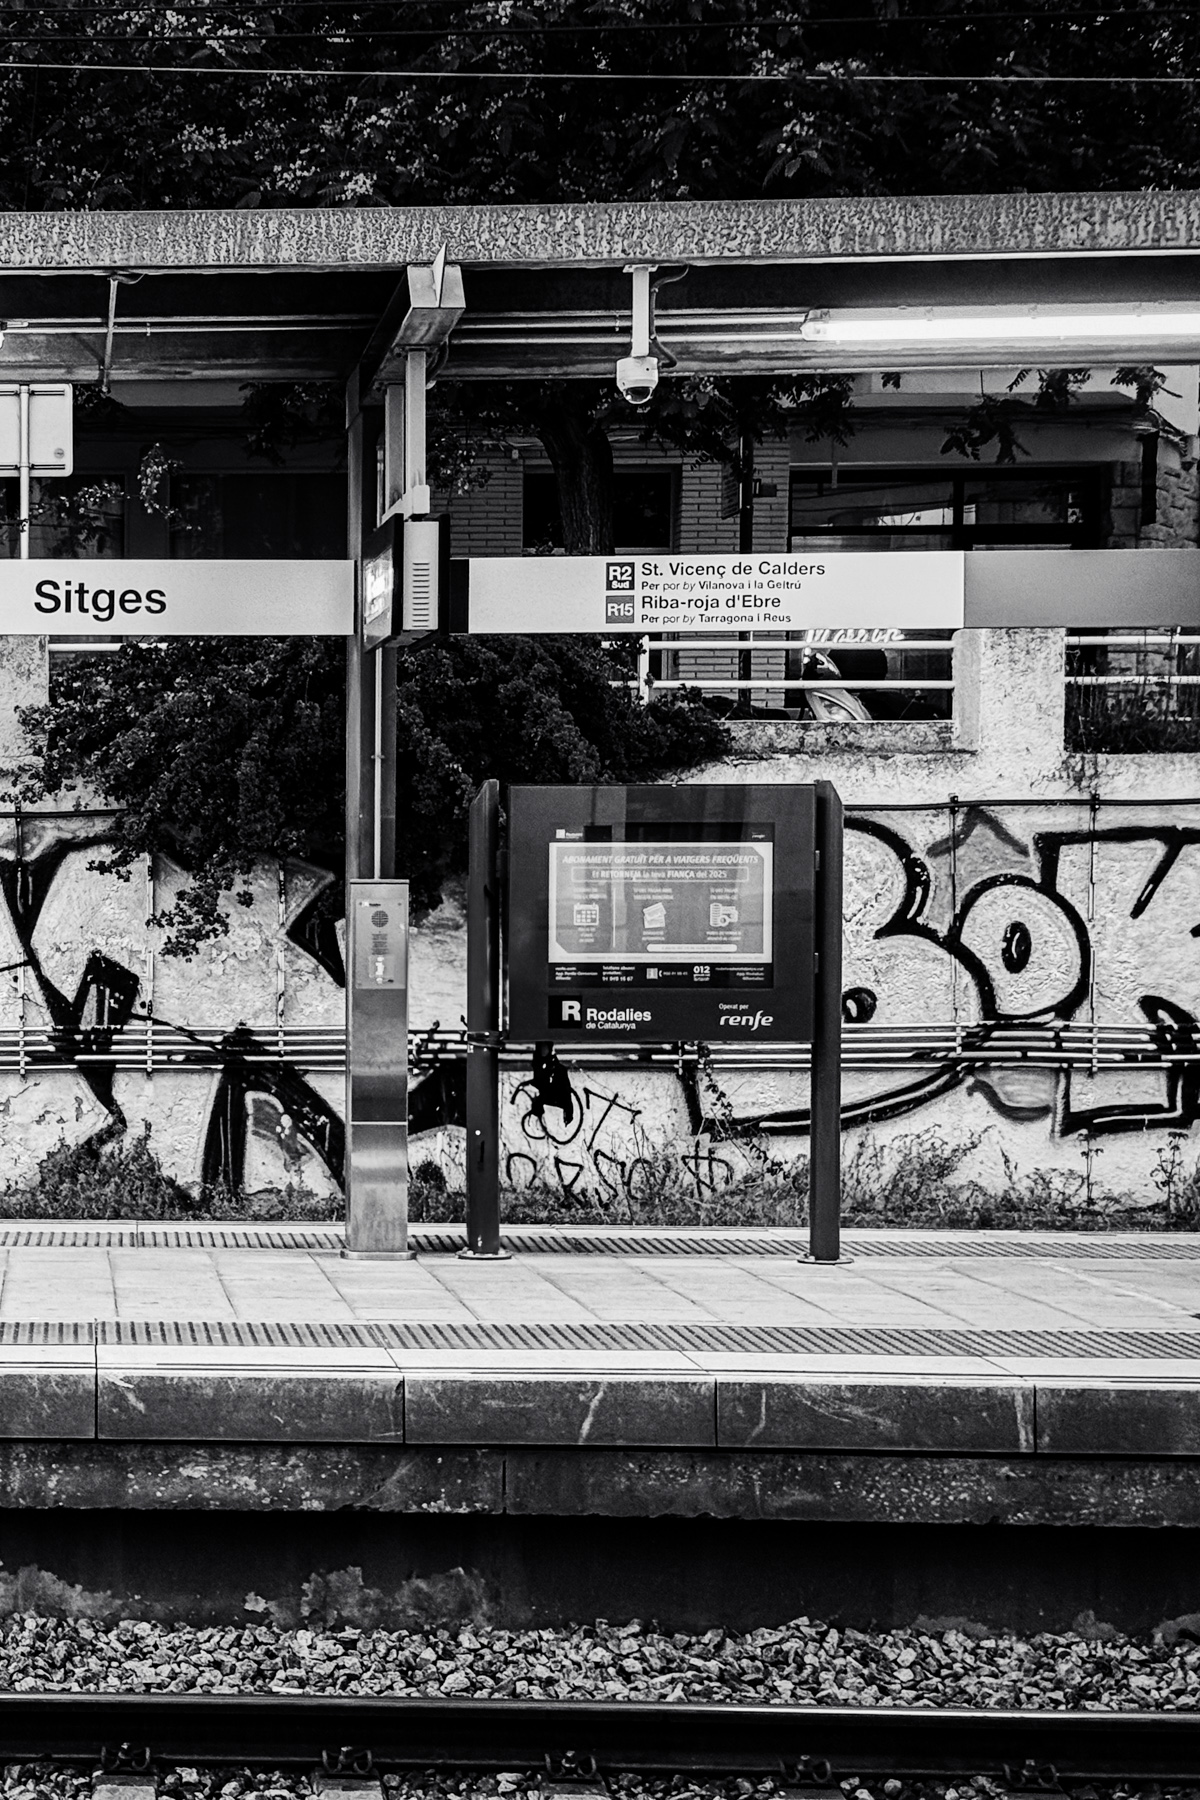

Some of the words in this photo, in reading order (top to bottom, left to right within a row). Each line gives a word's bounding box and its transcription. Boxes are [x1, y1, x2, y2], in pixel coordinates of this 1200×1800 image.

[609, 566, 632, 581] R2
[641, 562, 663, 576] St.
[669, 562, 726, 579] Vicenç
[732, 561, 753, 575] de
[758, 561, 826, 575] Calders
[611, 580, 630, 589] Sud
[641, 581, 660, 590] Per
[663, 583, 681, 592] por
[682, 581, 696, 592] by
[698, 580, 745, 590] Vilanova
[754, 580, 764, 590] la
[767, 580, 801, 590] Geltrú
[33, 580, 167, 622] Sitges
[641, 595, 720, 611] Riba-roja
[725, 594, 781, 608] d'Ebre
[607, 603, 634, 617] R15
[641, 614, 660, 623] Per
[663, 616, 681, 625] por
[682, 614, 696, 625] by
[698, 613, 754, 624] Tarragona
[763, 613, 792, 623] Reus
[562, 855, 613, 864] ABONAMENT
[673, 855, 711, 864] VIATGERS
[667, 870, 695, 879] FIANÇA
[709, 870, 727, 878] 2025
[693, 965, 711, 974] 012
[562, 1000, 581, 1021] R
[586, 1008, 652, 1021] Rodalies
[585, 1021, 596, 1029] de
[597, 1021, 636, 1031] Catalunya
[719, 1010, 774, 1031] renfe
